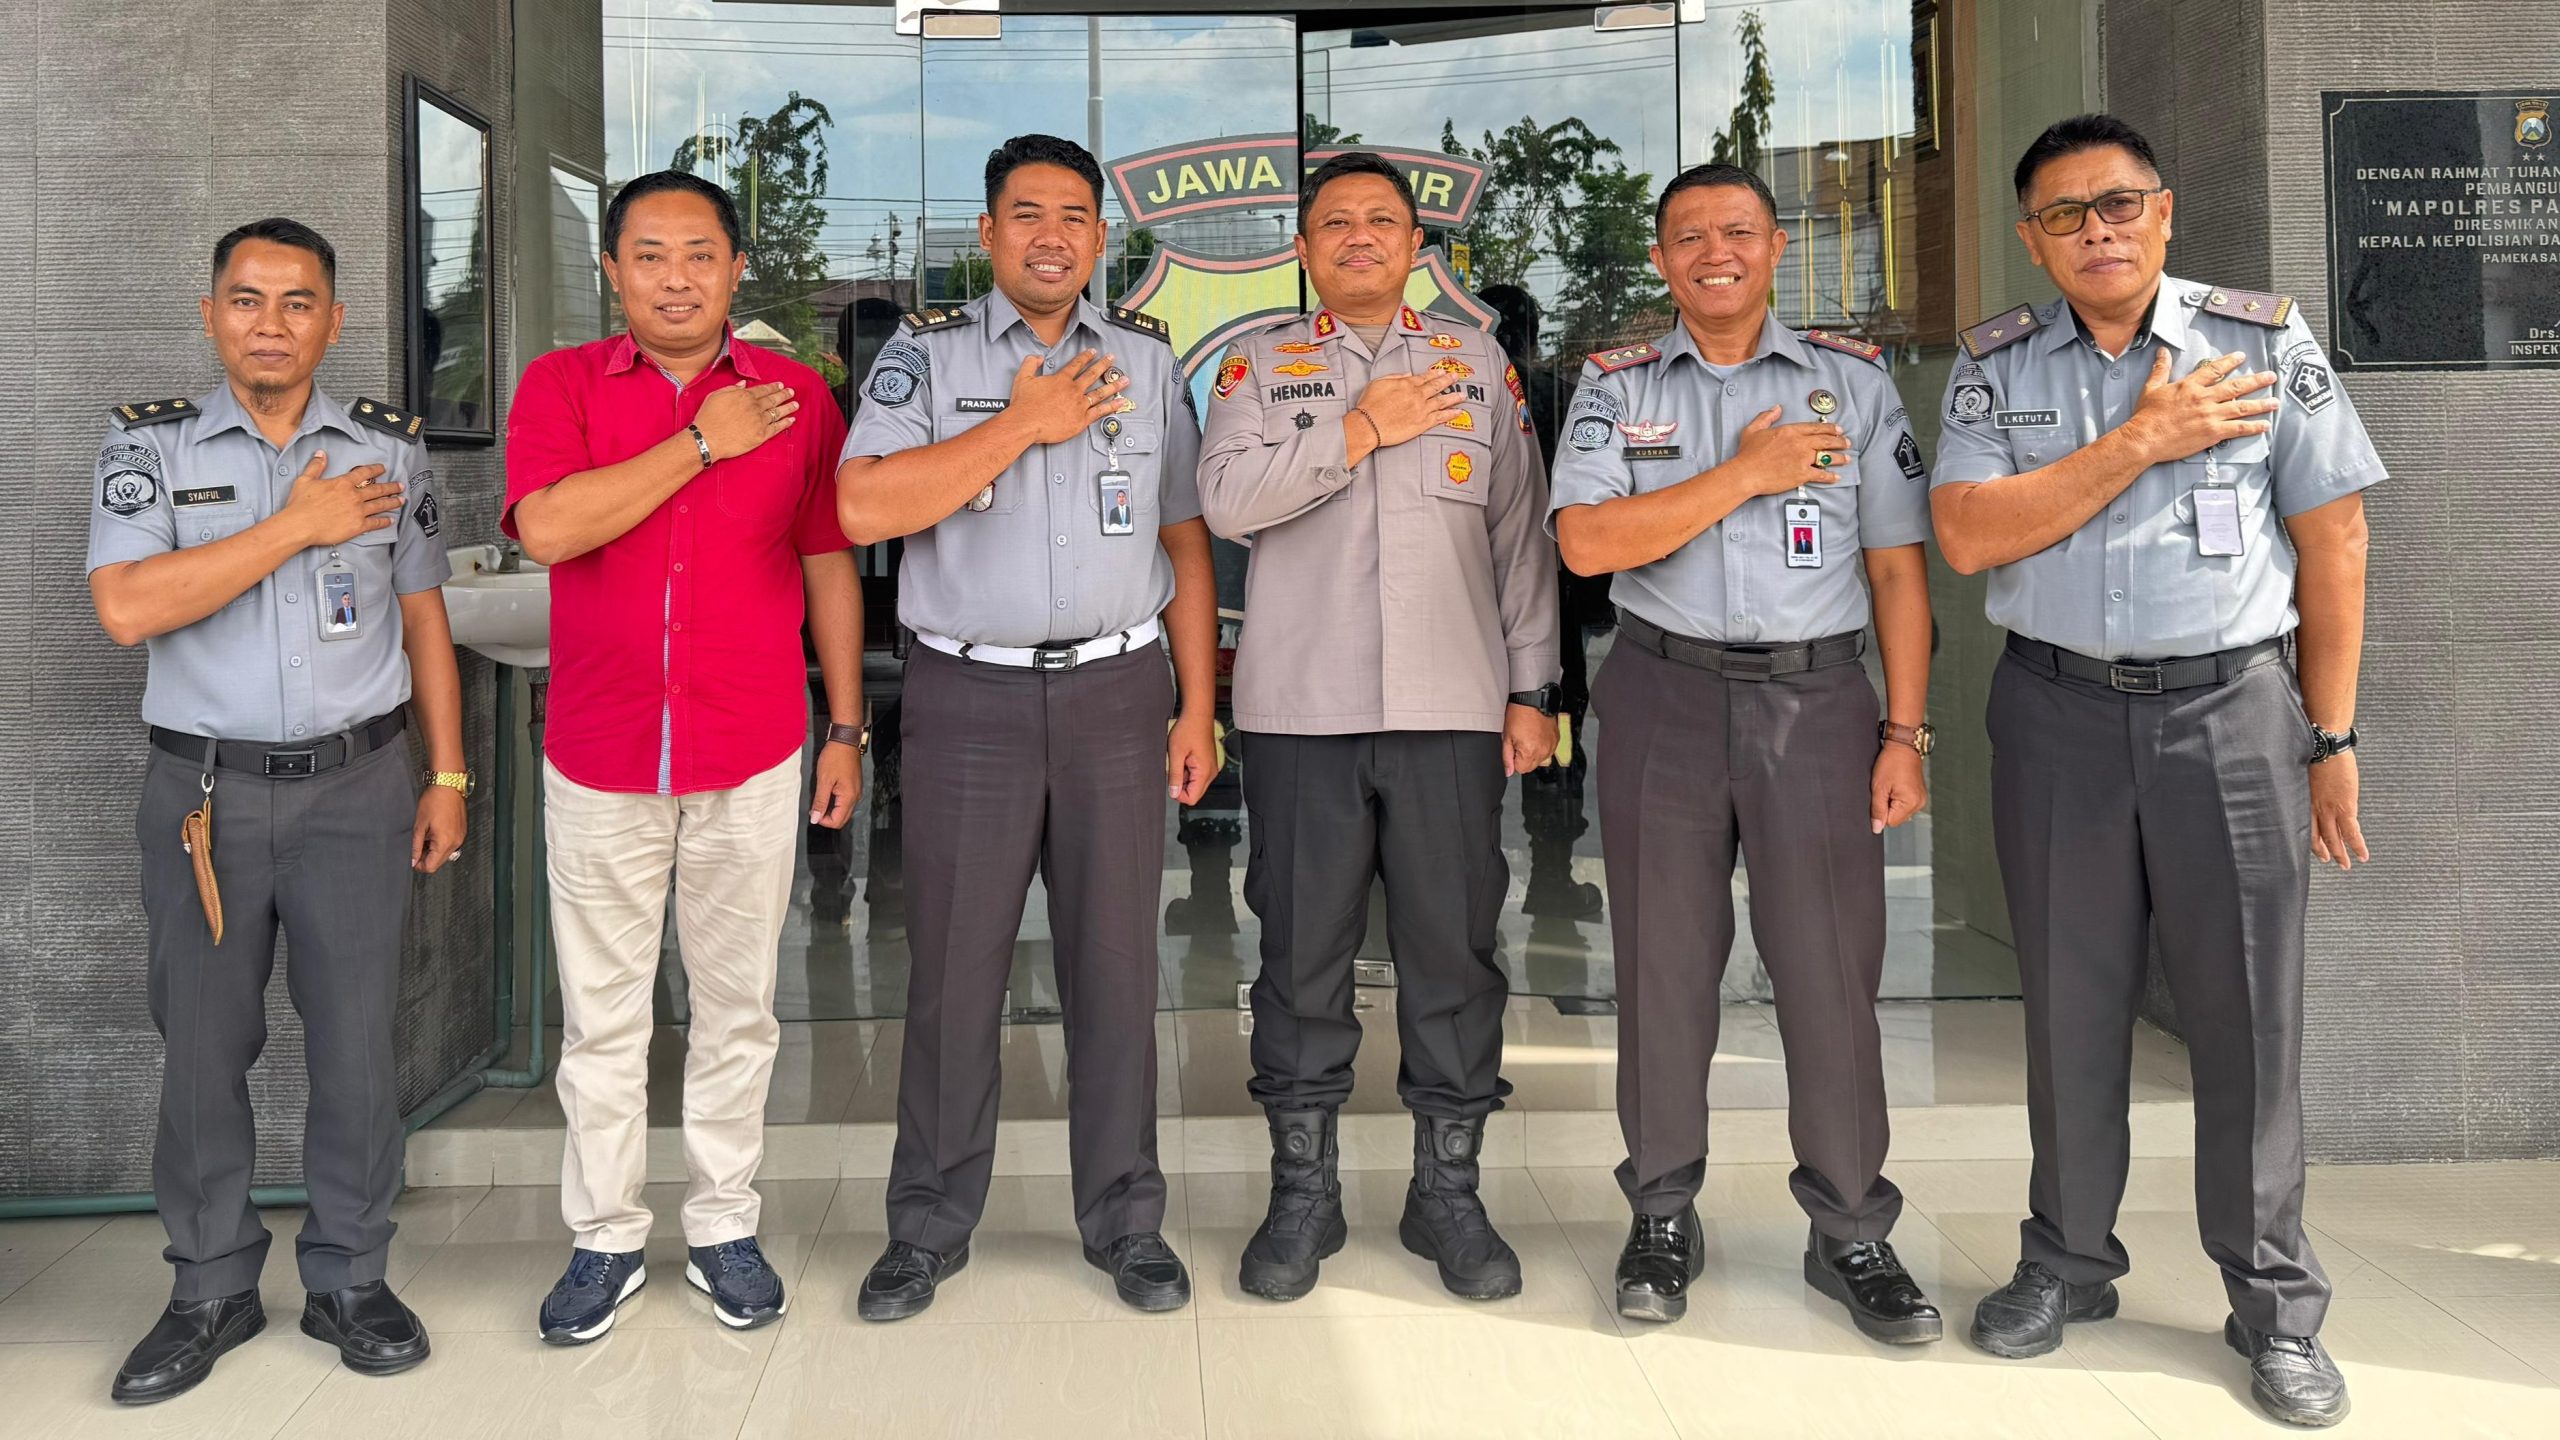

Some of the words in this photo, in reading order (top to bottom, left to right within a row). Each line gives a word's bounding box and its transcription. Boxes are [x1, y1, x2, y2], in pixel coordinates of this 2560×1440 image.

[2357, 168, 2425, 180] DENGAN
[2431, 166, 2500, 179] RAHMAT
[1148, 156, 1282, 204] JAWA
[2465, 181, 2560, 195] PEMBANGU
[2454, 218, 2558, 230] DIRESMIKAN
[2359, 235, 2426, 248] KEPALA
[2432, 234, 2533, 248] KEPOLISIAN
[2482, 252, 2560, 263] PAMEKASA
[2529, 327, 2560, 339] Drs.
[1270, 382, 1336, 403] HENDRA
[961, 400, 1005, 408] PRADANA
[2045, 413, 2051, 422] A
[187, 490, 221, 502] SYAIFUL
